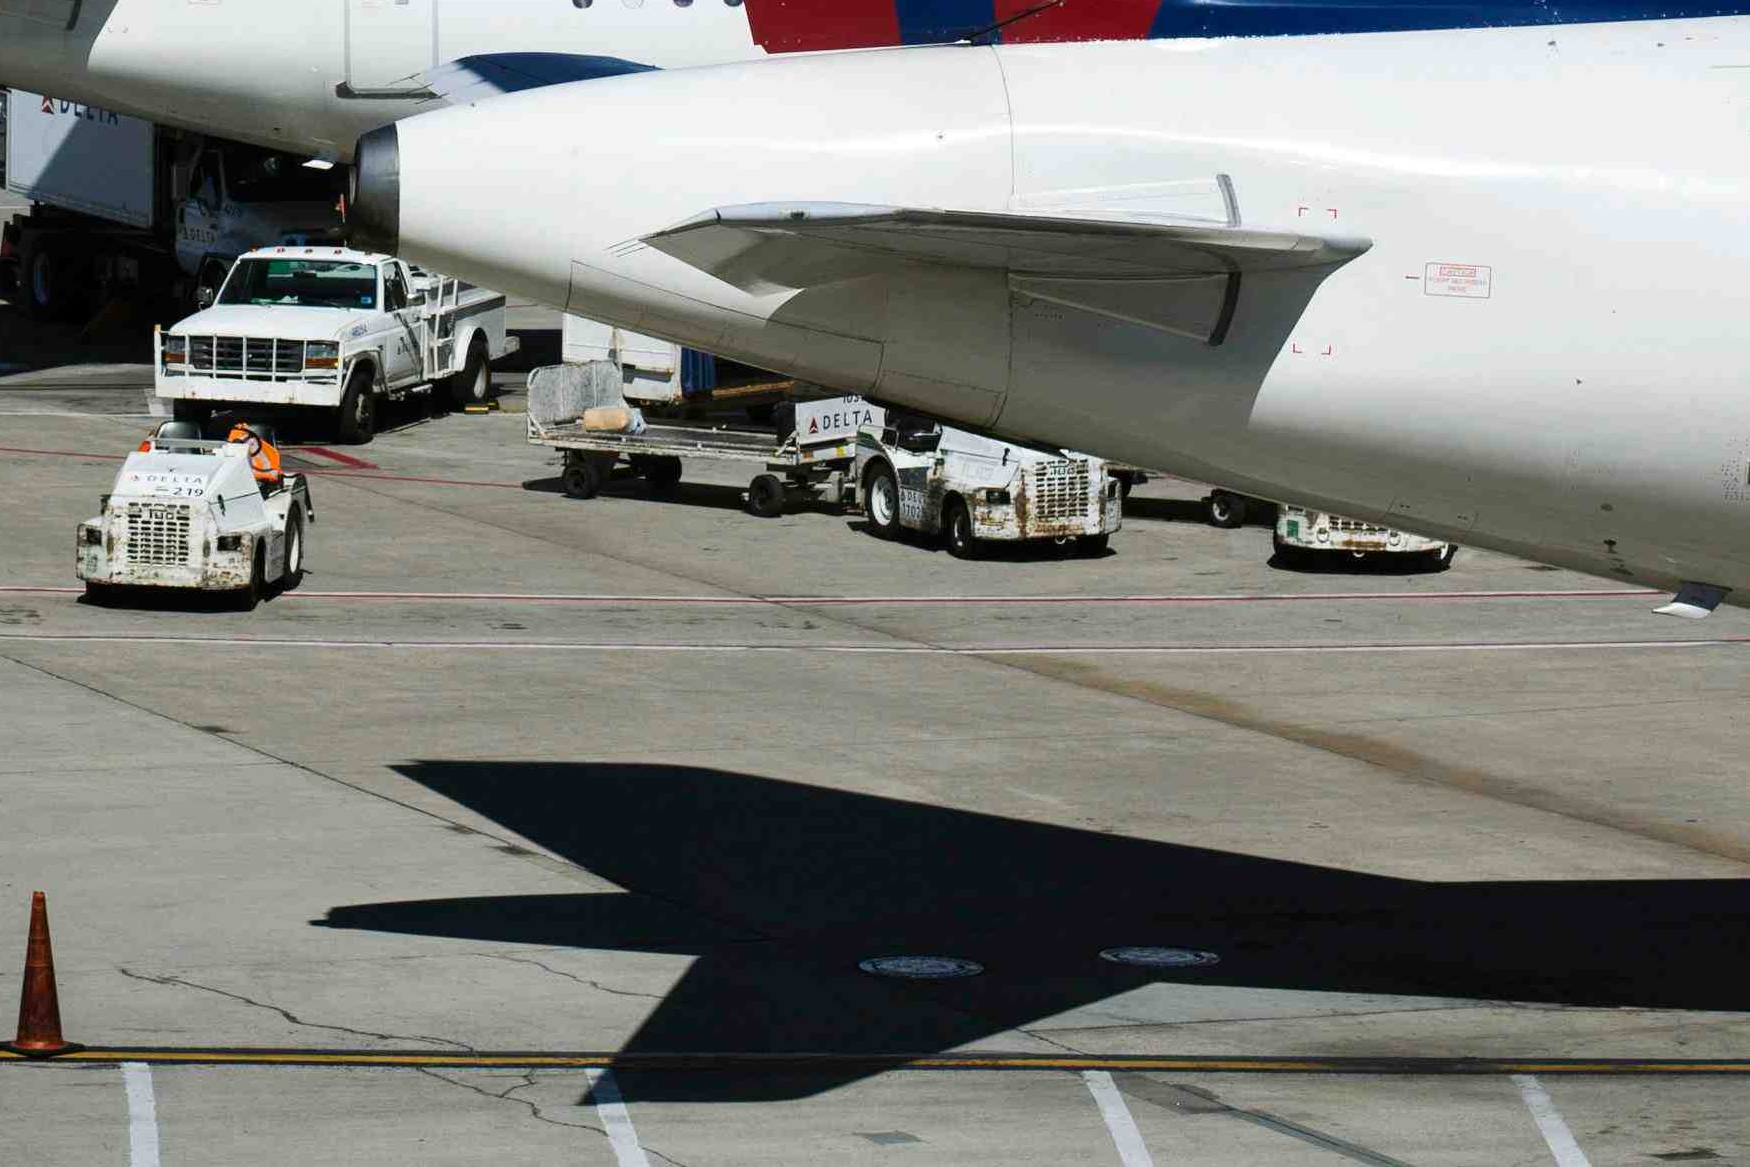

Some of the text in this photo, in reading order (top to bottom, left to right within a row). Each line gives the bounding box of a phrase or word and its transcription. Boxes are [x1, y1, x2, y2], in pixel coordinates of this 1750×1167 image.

[822, 409, 873, 430] DELTA
[146, 474, 203, 484] DELTA
[172, 486, 204, 498] 219
